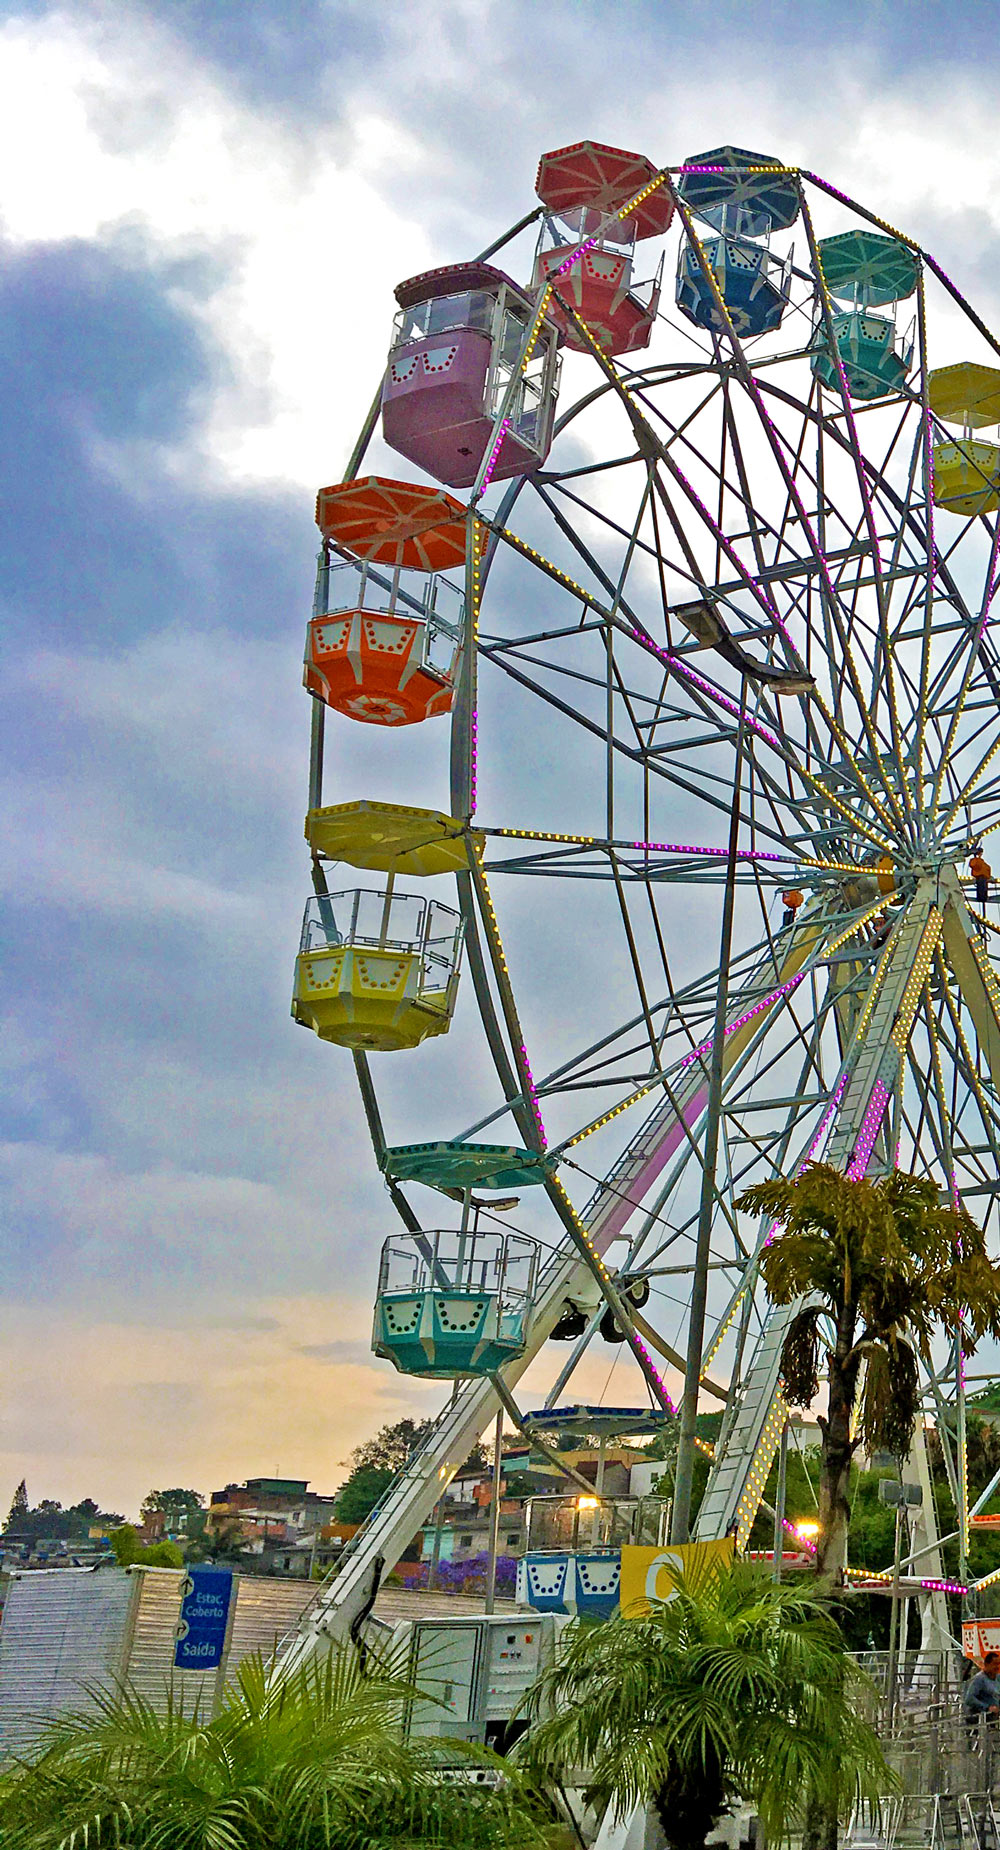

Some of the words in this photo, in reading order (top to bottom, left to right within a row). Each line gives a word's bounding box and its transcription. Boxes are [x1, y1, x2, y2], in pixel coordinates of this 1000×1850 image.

[196, 1592, 224, 1605] Estac.
[185, 1605, 224, 1618] Coberto
[182, 1641, 216, 1656] Saída
